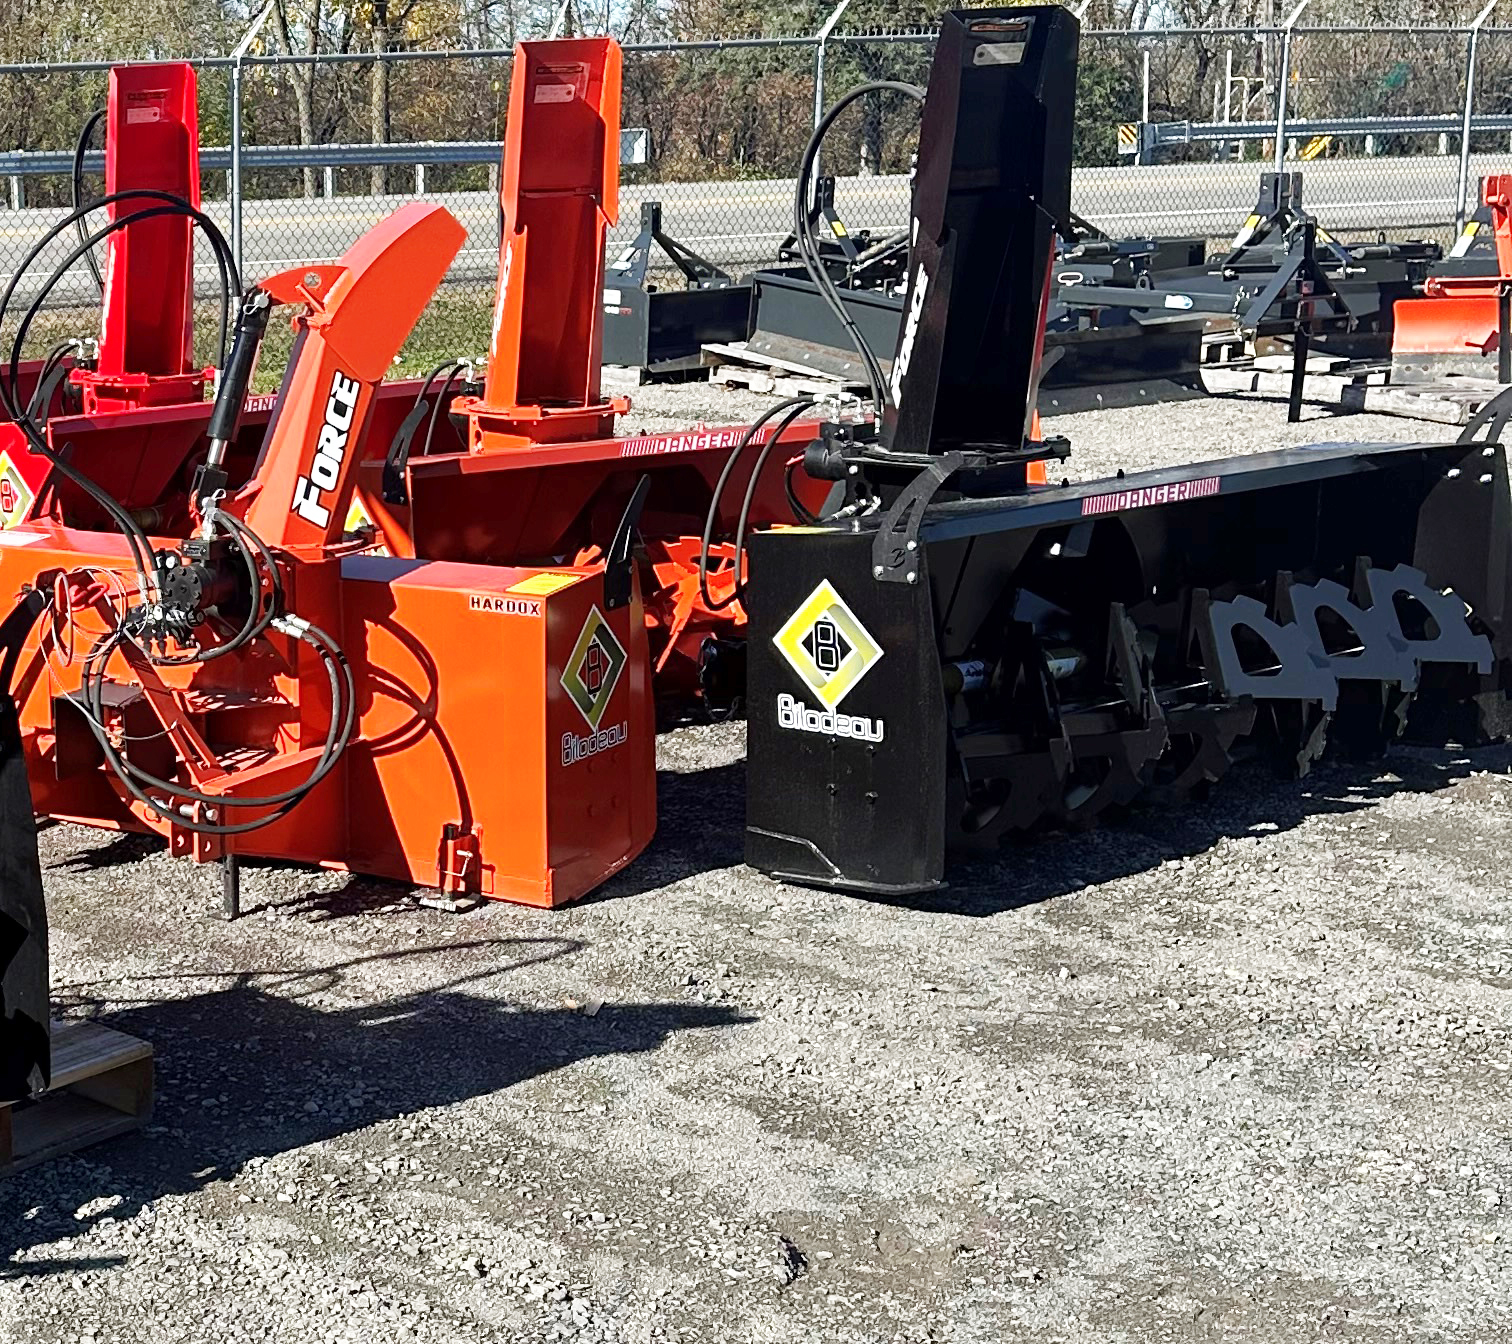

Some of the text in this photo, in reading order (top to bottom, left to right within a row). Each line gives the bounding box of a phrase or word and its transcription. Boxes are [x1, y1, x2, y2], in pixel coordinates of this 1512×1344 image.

[291, 370, 361, 529] FORCE
[657, 432, 732, 454] DANGER
[1117, 482, 1191, 510] DANGER
[470, 596, 541, 616] HARDOX
[777, 692, 885, 743] Bilodeau
[561, 720, 628, 767] Bilodeau
